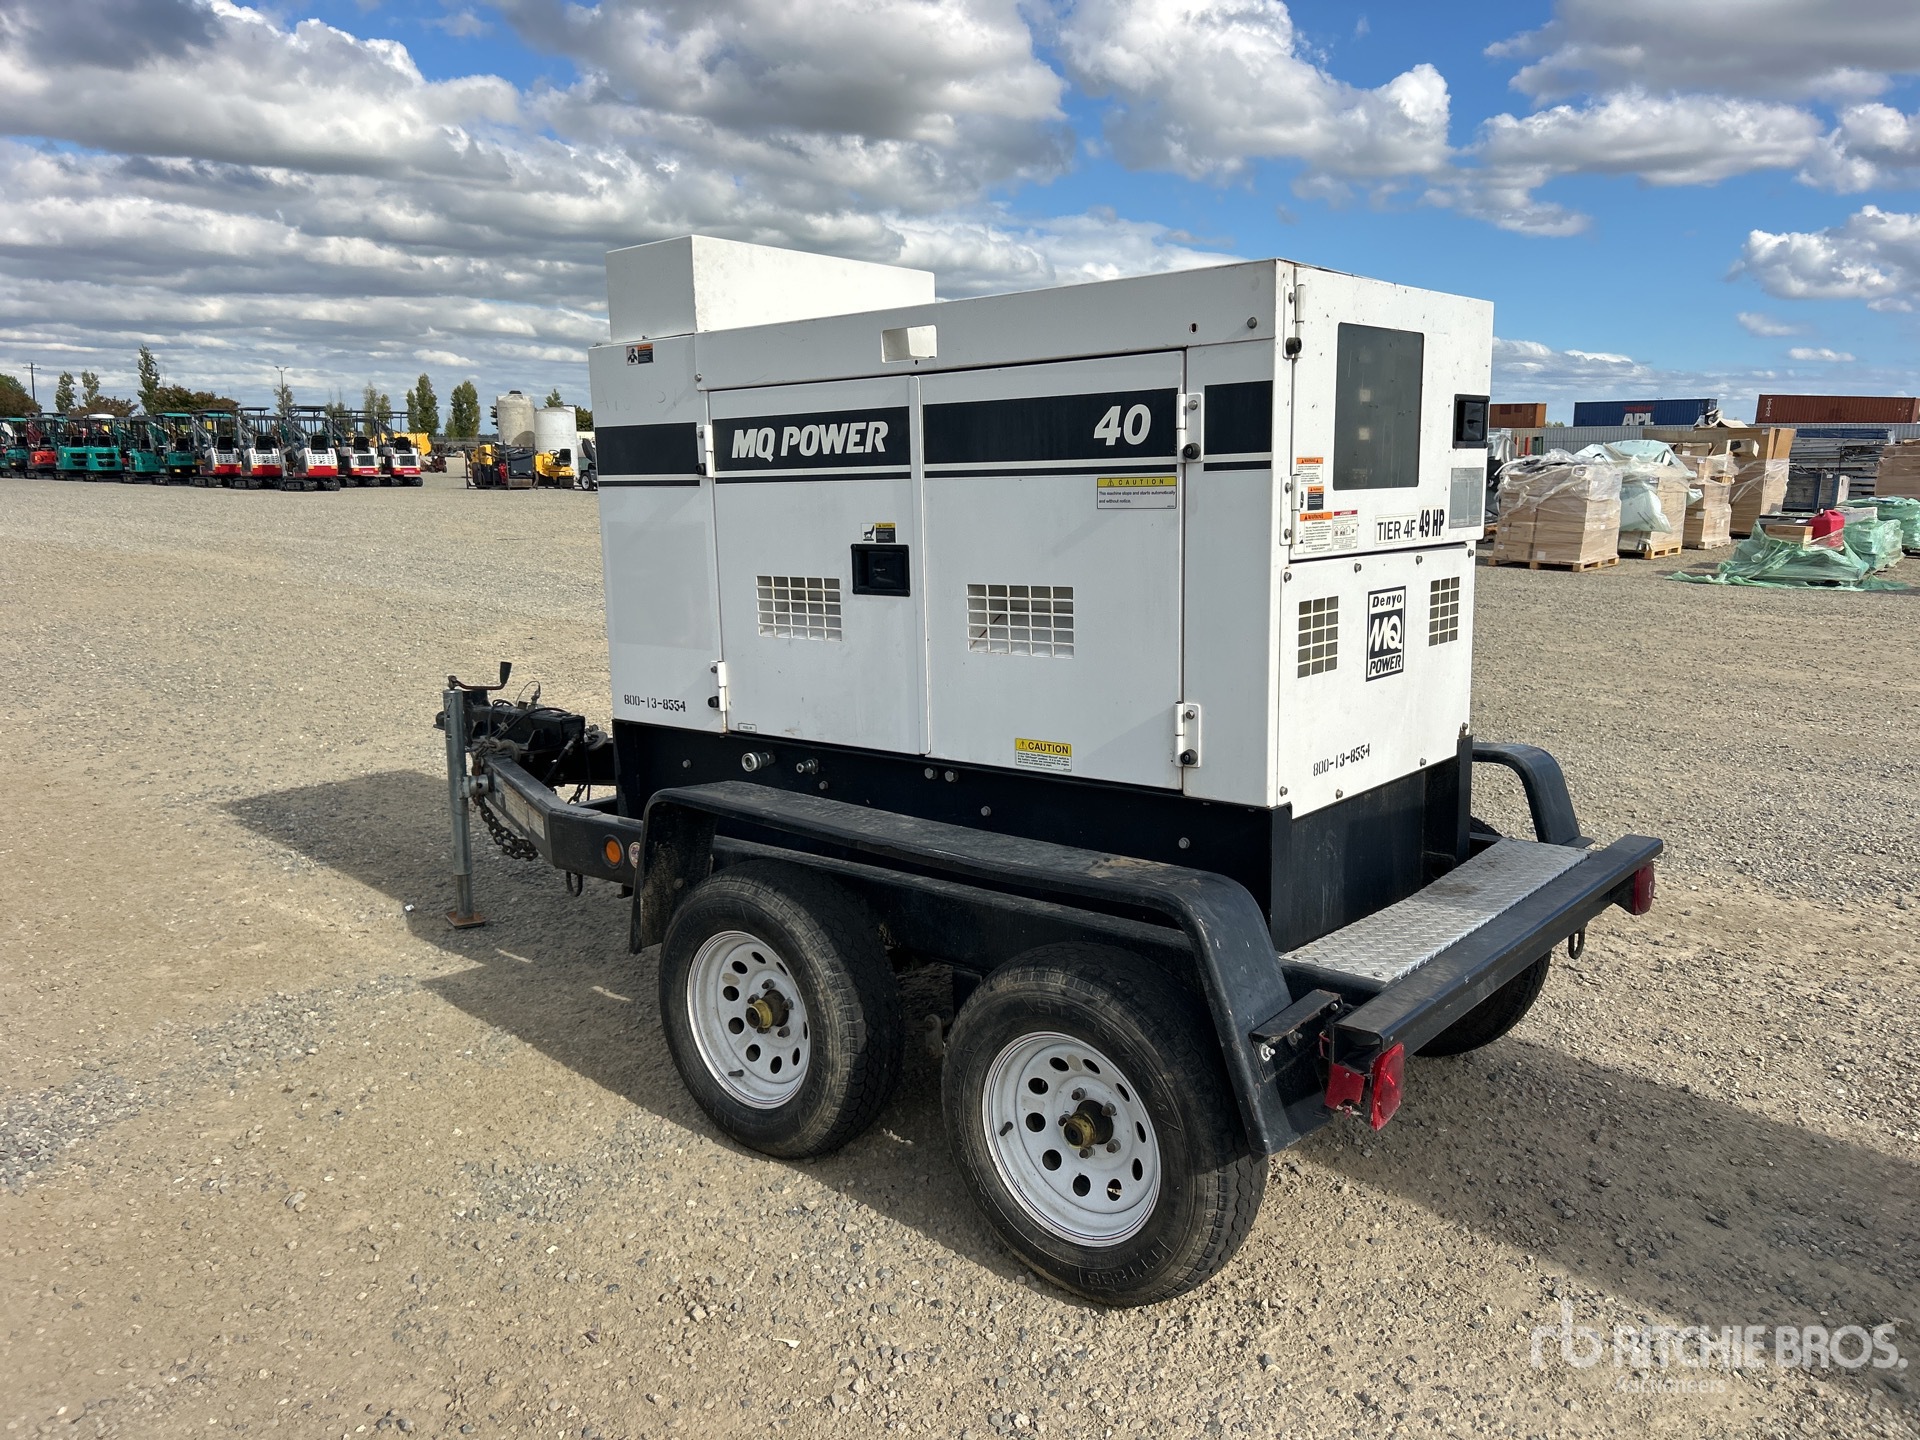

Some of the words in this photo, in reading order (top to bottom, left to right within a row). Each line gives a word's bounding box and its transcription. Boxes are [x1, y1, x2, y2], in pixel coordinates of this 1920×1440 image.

[1093, 403, 1152, 446] 40
[1621, 412, 1655, 426] APL
[731, 427, 776, 463] MQ
[780, 420, 889, 457] POWER
[1118, 478, 1164, 486] CAUTION
[1377, 521, 1401, 541] TIER
[1403, 519, 1416, 538] 4F
[1418, 509, 1431, 538] 49
[1432, 508, 1445, 537] HP
[1372, 594, 1402, 608] Denyo
[1369, 614, 1402, 652] MQ
[1369, 654, 1401, 676] POWER
[623, 694, 686, 712] 800-13-8554
[1027, 741, 1069, 754] CAUTION
[1313, 743, 1370, 777] 800-13-8554
